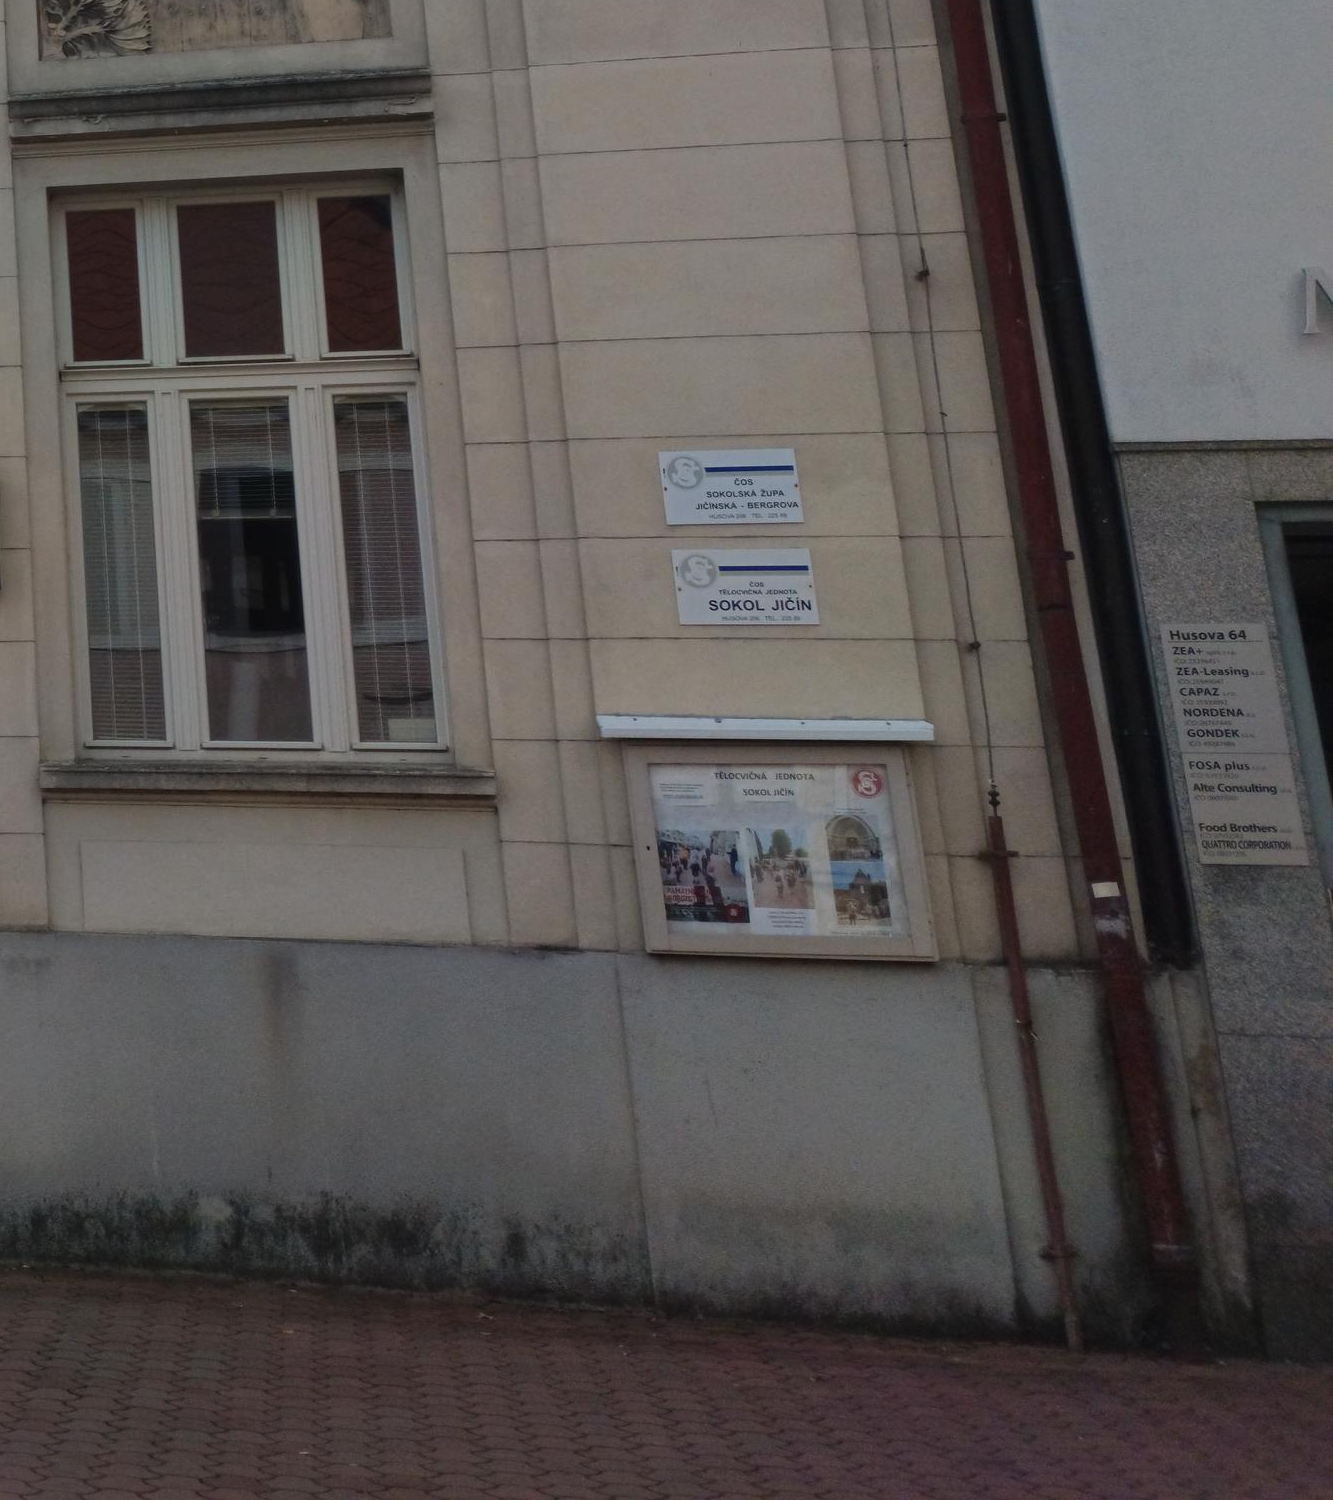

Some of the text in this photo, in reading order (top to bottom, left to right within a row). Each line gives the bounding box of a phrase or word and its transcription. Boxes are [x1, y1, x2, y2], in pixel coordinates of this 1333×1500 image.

[734, 477, 754, 486] ČOS
[760, 489, 785, 497] ŽUPA
[747, 501, 799, 509] BERGROVA
[709, 597, 812, 611] SOKOL JIČÍN
[1169, 629, 1247, 640] Husova 64
[1172, 646, 1203, 655] ZEA+
[1175, 666, 1249, 678] ZEA-Leasing
[1179, 687, 1220, 696] CAPAZ
[1183, 708, 1244, 717] NORDENA
[1187, 729, 1240, 737] GONDEK
[1189, 761, 1221, 770] FOSA
[1224, 761, 1250, 772] plus
[714, 770, 815, 781] TĚLOCVIČNÁ JEDNOTA
[742, 786, 795, 796] SOKOL JIČÍN
[1193, 783, 1214, 792] Alte
[1217, 783, 1277, 795] Consulting
[1199, 822, 1227, 832] Food
[1229, 823, 1277, 833] Brothers
[1201, 840, 1237, 850] QUATTRO
[1238, 840, 1292, 850] CORPORATION
